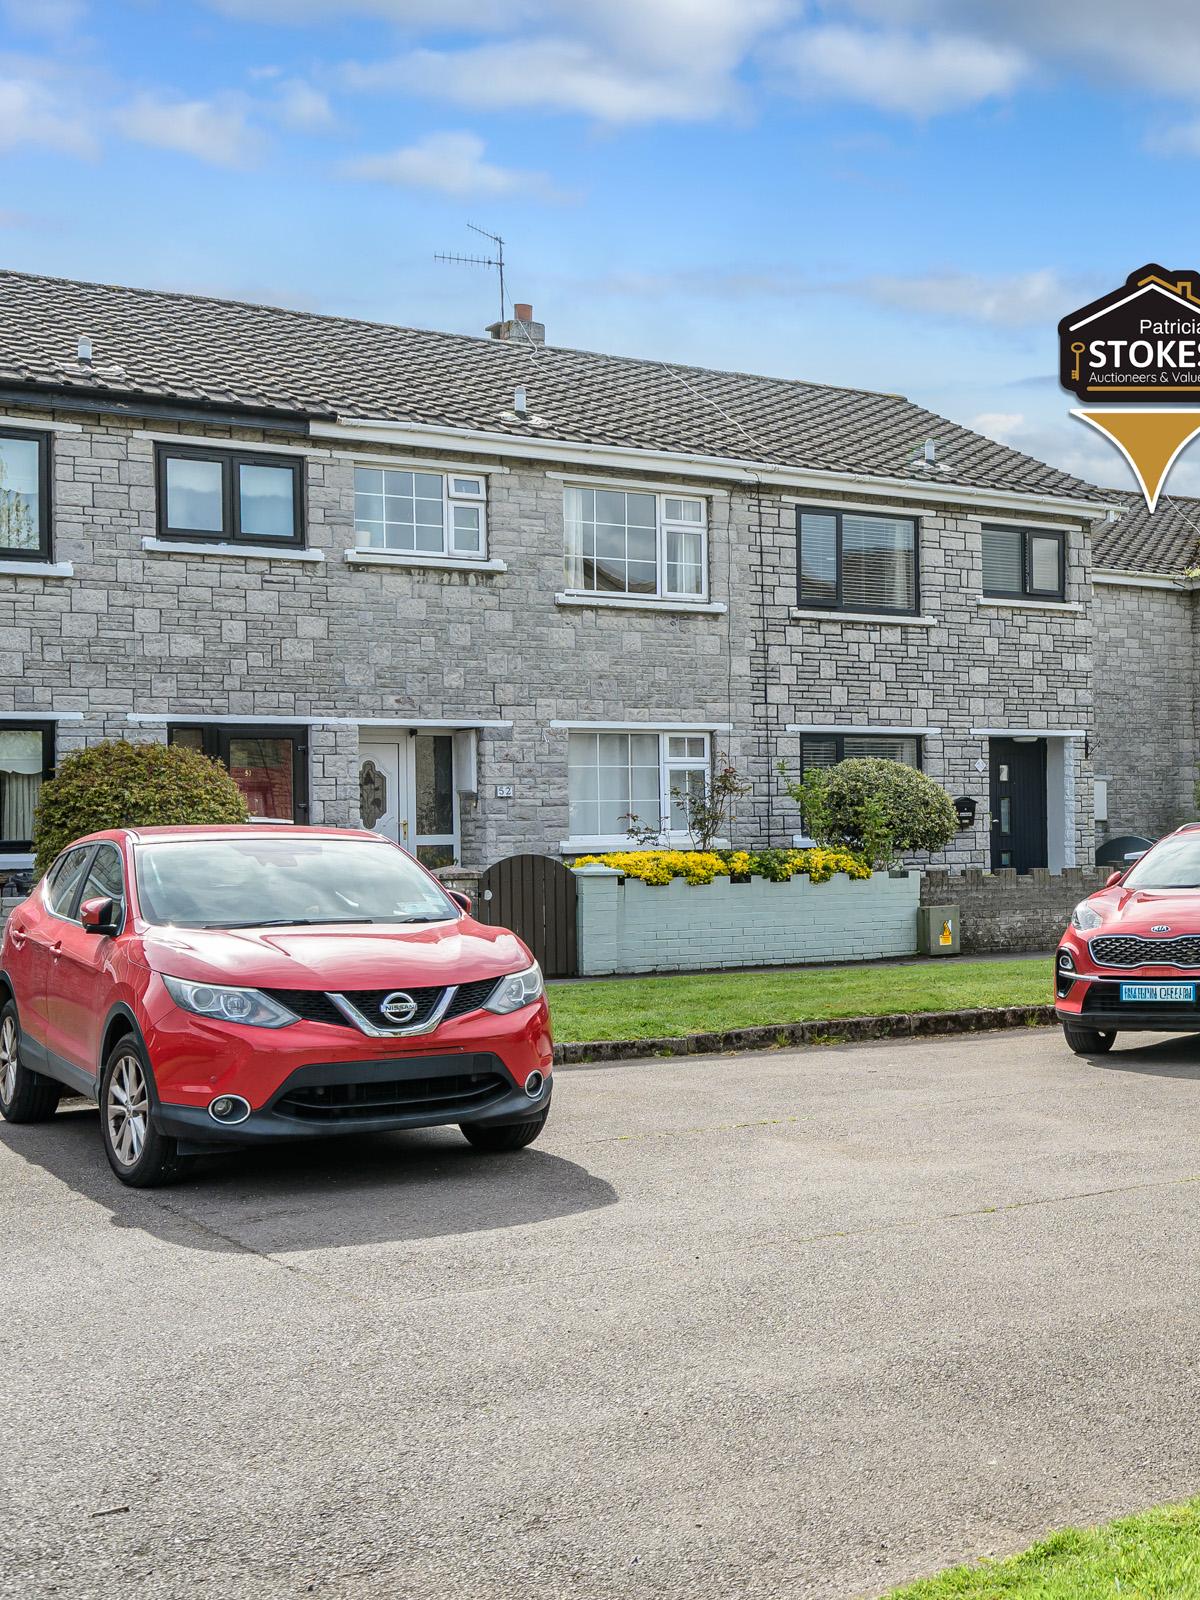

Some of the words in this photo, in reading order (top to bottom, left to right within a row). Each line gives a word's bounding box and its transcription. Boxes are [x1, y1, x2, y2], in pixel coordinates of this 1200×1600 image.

[498, 786, 511, 796] 52
[1151, 925, 1170, 933] KIA
[384, 1003, 417, 1011] NISSAN
